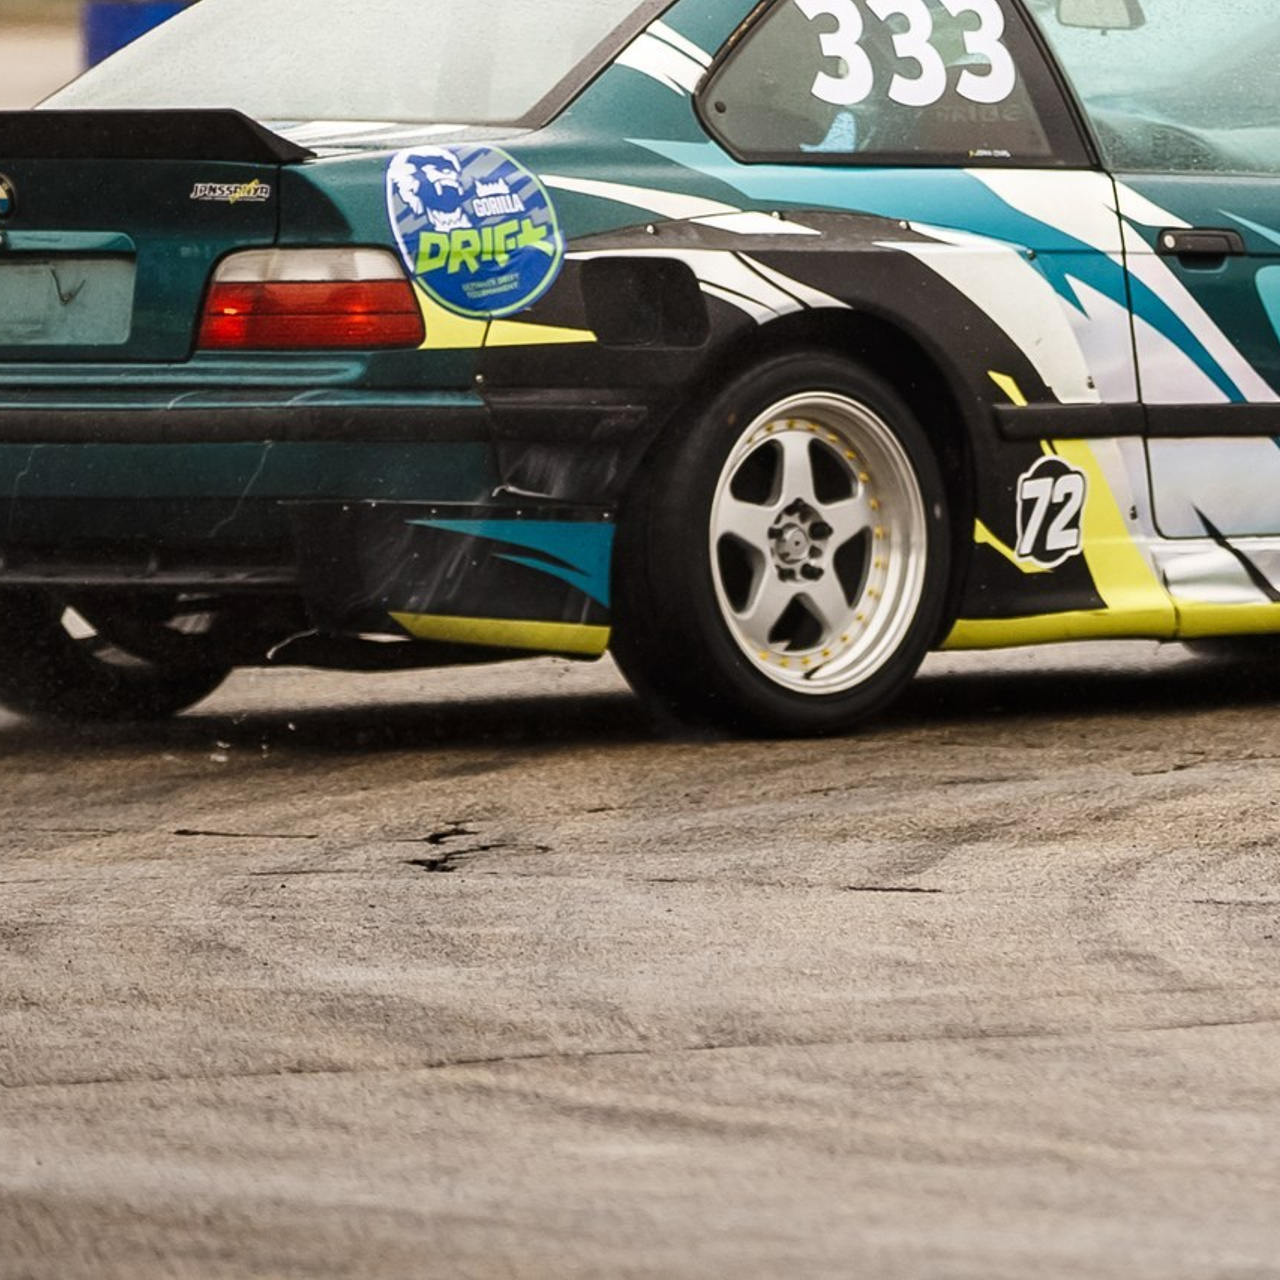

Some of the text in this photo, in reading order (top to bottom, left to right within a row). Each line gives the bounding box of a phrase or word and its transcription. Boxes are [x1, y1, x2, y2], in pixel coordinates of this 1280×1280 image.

[472, 193, 525, 217] GORILLA
[414, 218, 554, 274] DRIFT
[1018, 473, 1085, 555] 72
